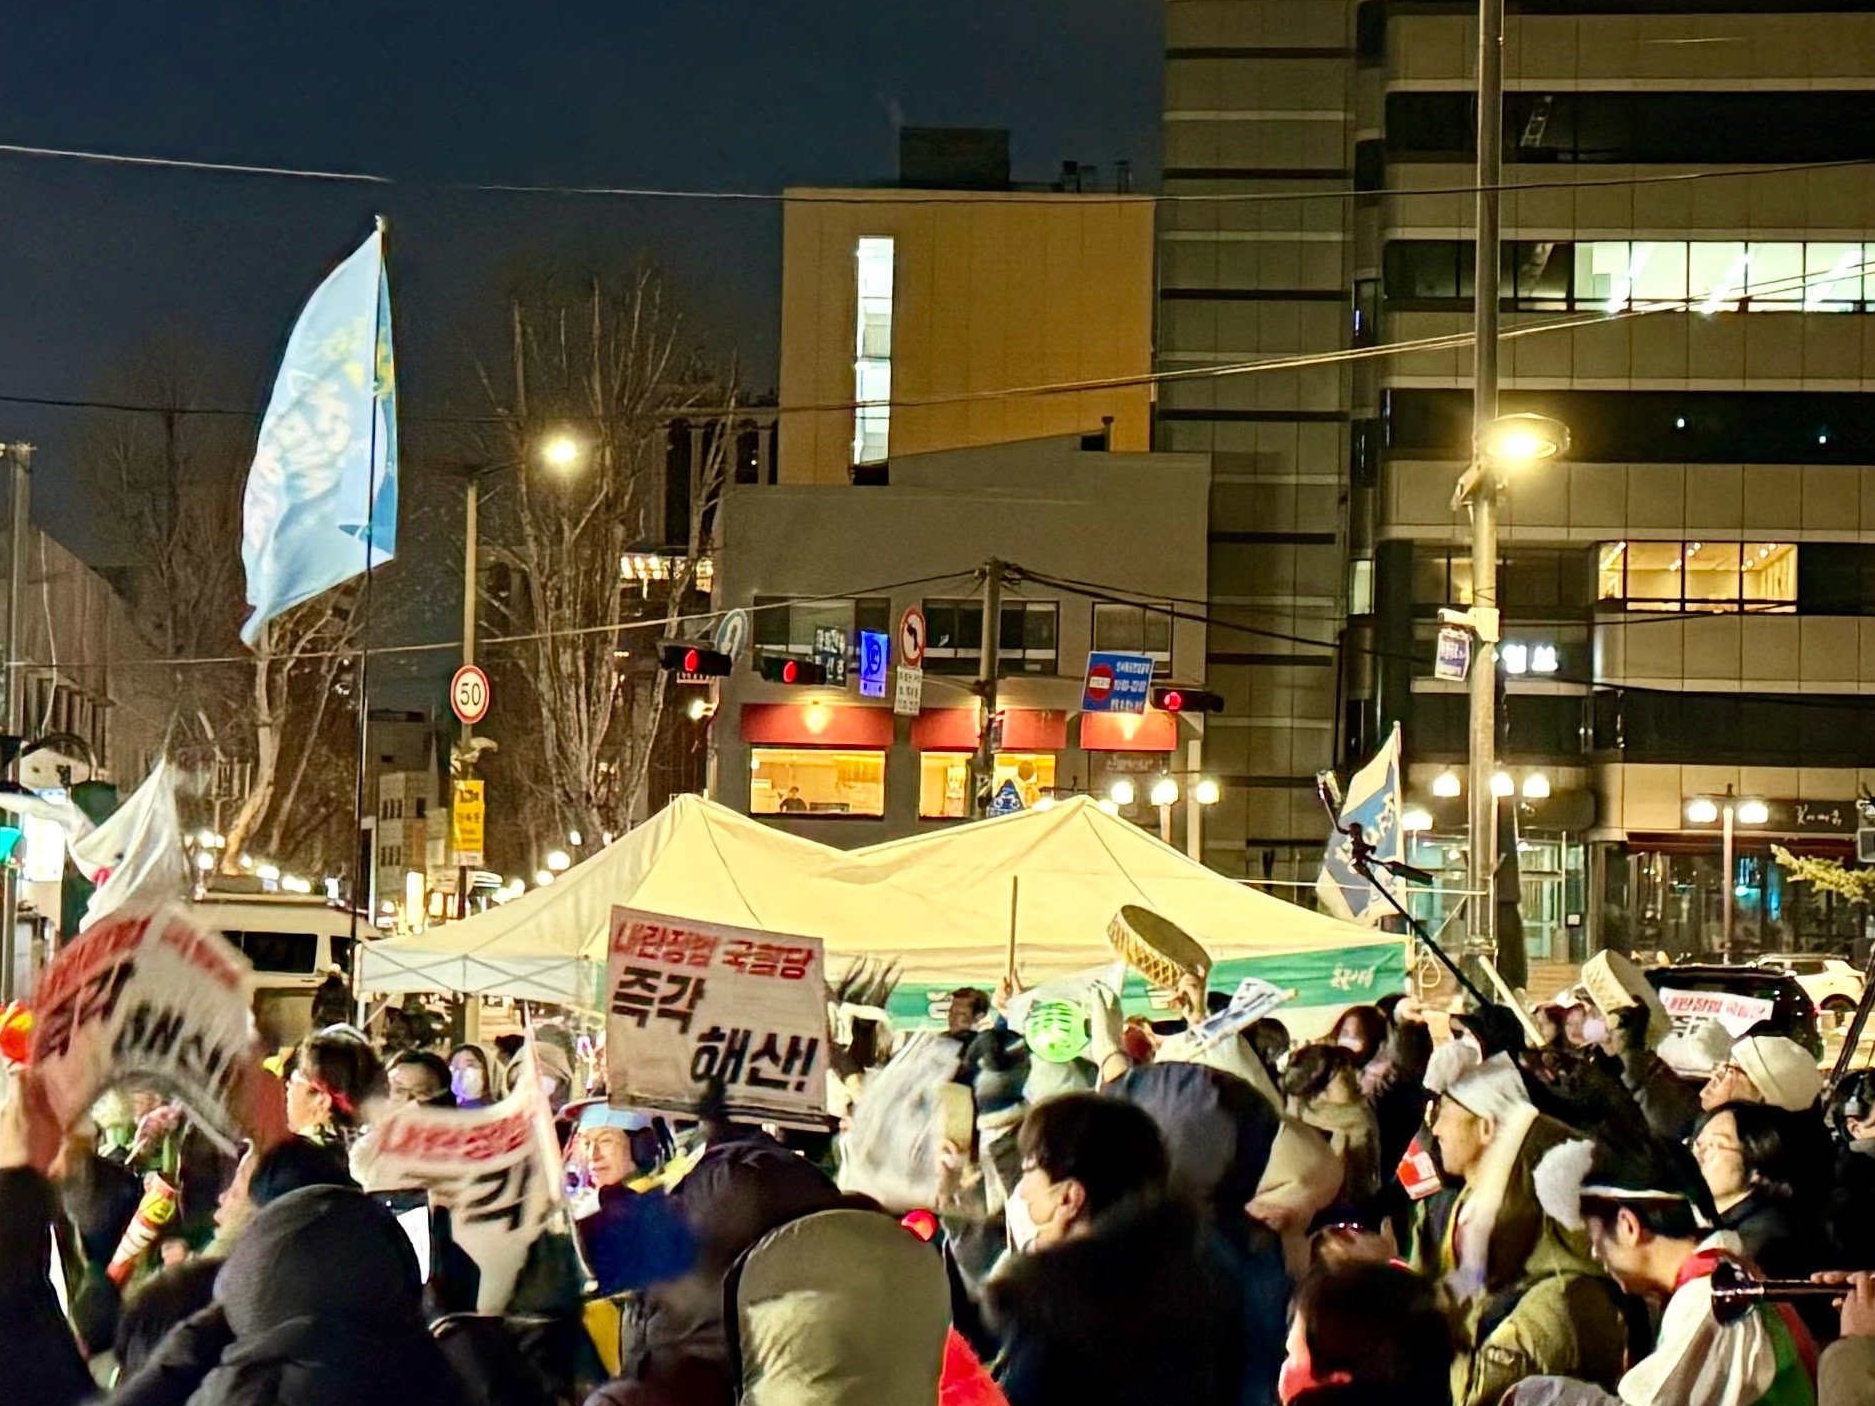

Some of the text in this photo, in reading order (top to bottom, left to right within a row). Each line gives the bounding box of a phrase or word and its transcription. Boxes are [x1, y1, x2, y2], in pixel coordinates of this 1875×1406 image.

[459, 682, 482, 706] 50
[611, 966, 707, 1035] 즉각
[690, 1026, 819, 1092] 해산!
